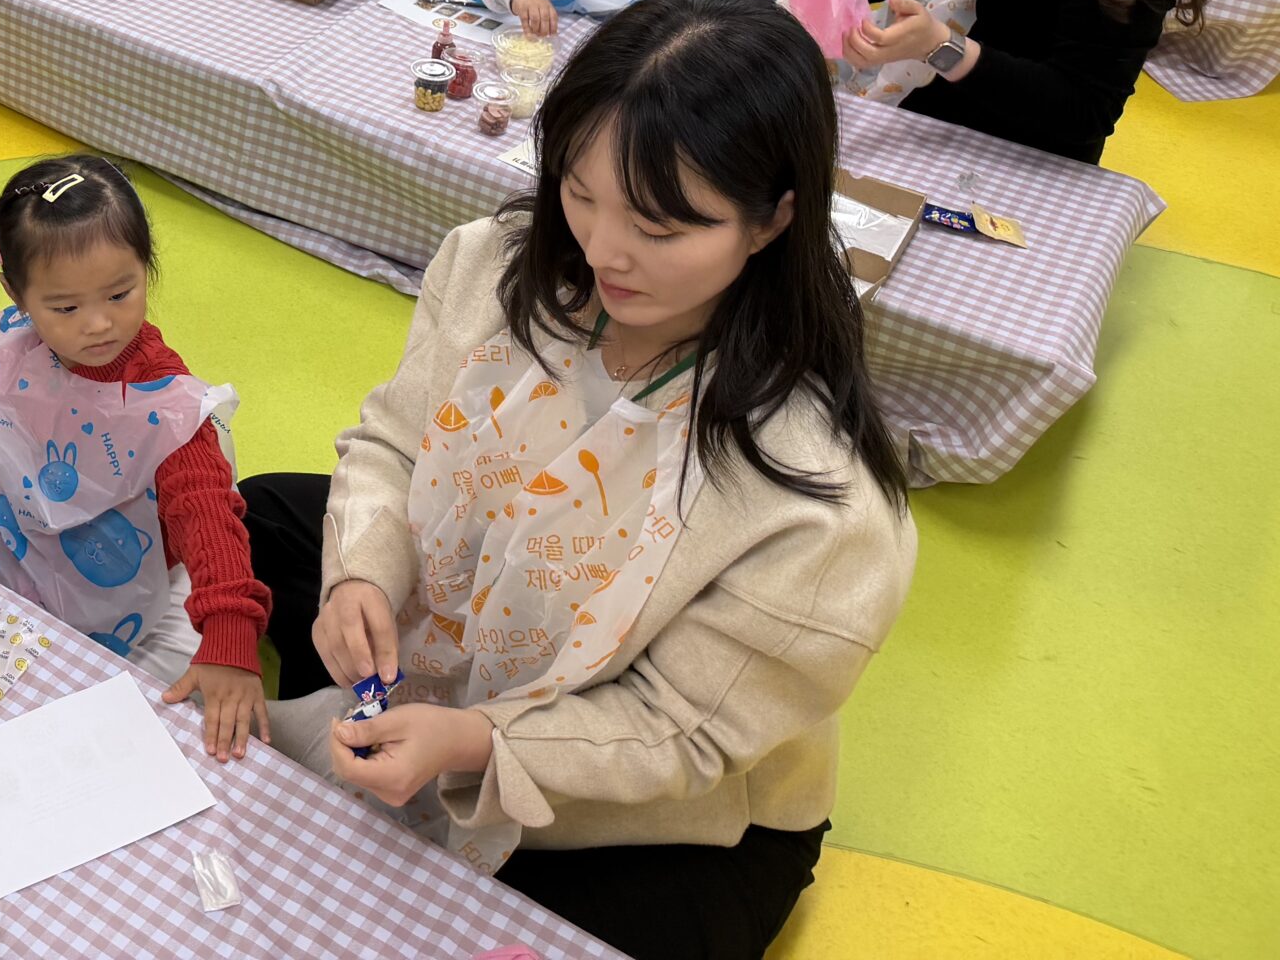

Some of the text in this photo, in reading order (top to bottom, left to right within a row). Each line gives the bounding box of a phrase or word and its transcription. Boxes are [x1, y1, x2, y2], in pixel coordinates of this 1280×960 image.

[101, 432, 123, 478] HAPPY
[480, 465, 523, 489] 이뻐
[526, 534, 564, 561] 먹을
